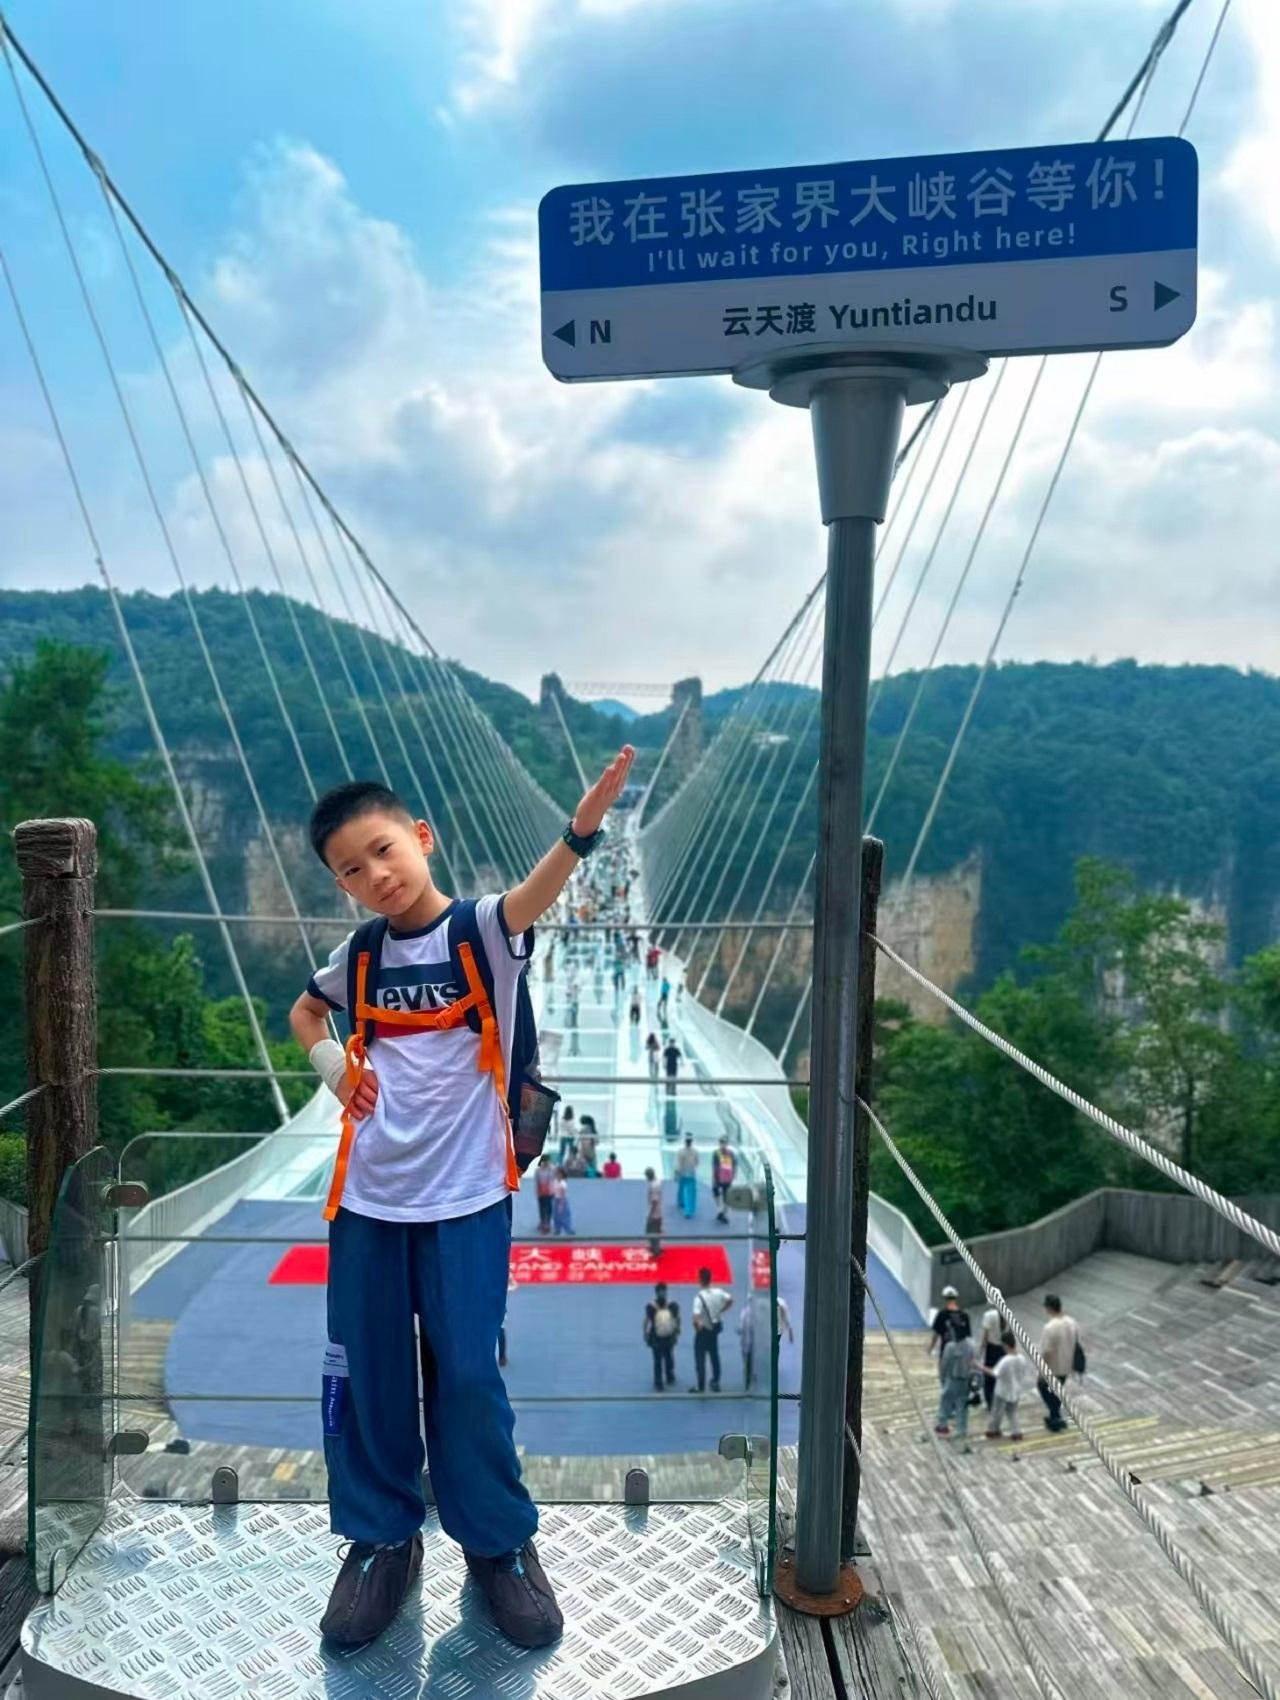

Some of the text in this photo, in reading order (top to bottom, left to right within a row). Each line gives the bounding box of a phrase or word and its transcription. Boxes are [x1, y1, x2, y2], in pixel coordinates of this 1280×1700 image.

[569, 156, 1165, 246] 我在张家界大峡谷等你！
[648, 222, 1075, 272] I'll wait for you, Right here!
[722, 294, 998, 337] 云天渡 Yuntiandu
[1109, 285, 1128, 313] S
[590, 319, 611, 345] N
[567, 1260, 658, 1272] CANYON
